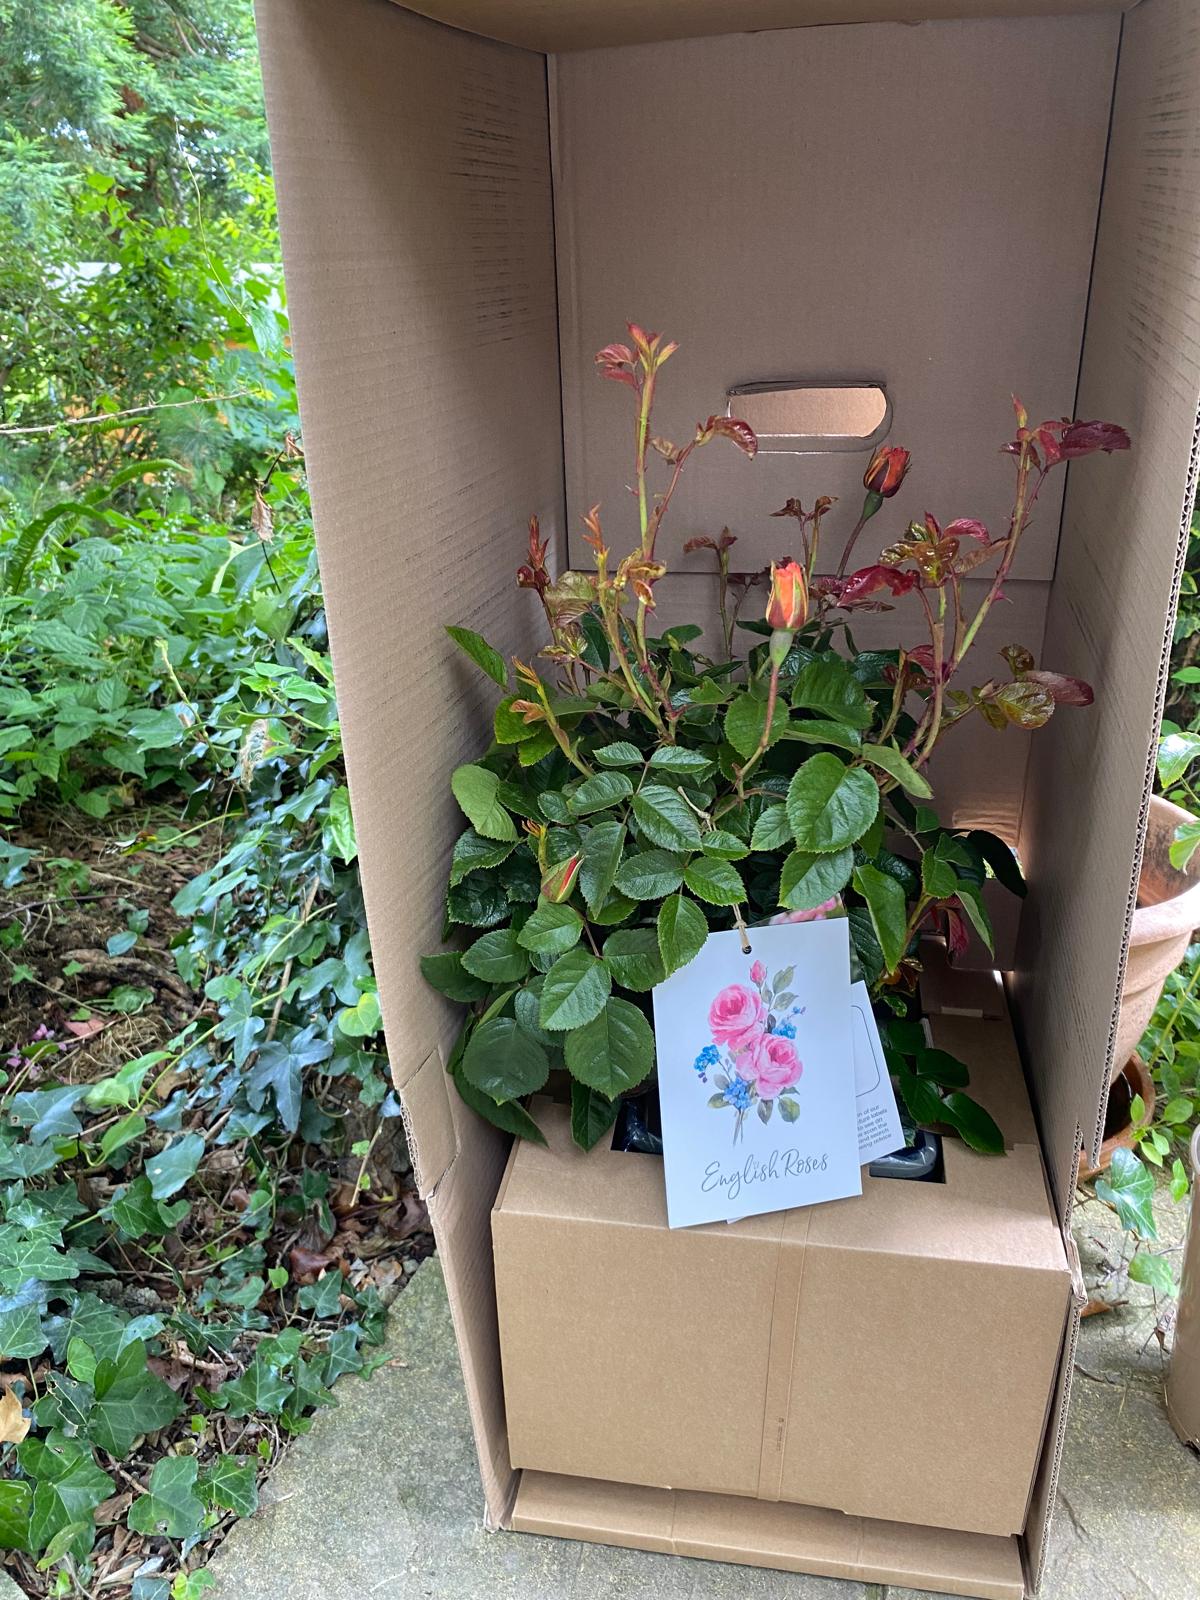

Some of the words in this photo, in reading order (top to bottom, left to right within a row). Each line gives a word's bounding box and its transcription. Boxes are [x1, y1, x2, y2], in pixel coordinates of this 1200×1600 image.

[871, 1108, 888, 1119] labels
[877, 1122, 888, 1130] the
[870, 1127, 890, 1139] search
[874, 1134, 892, 1144] advice
[701, 1149, 780, 1200] English
[781, 1148, 829, 1177] Roses
